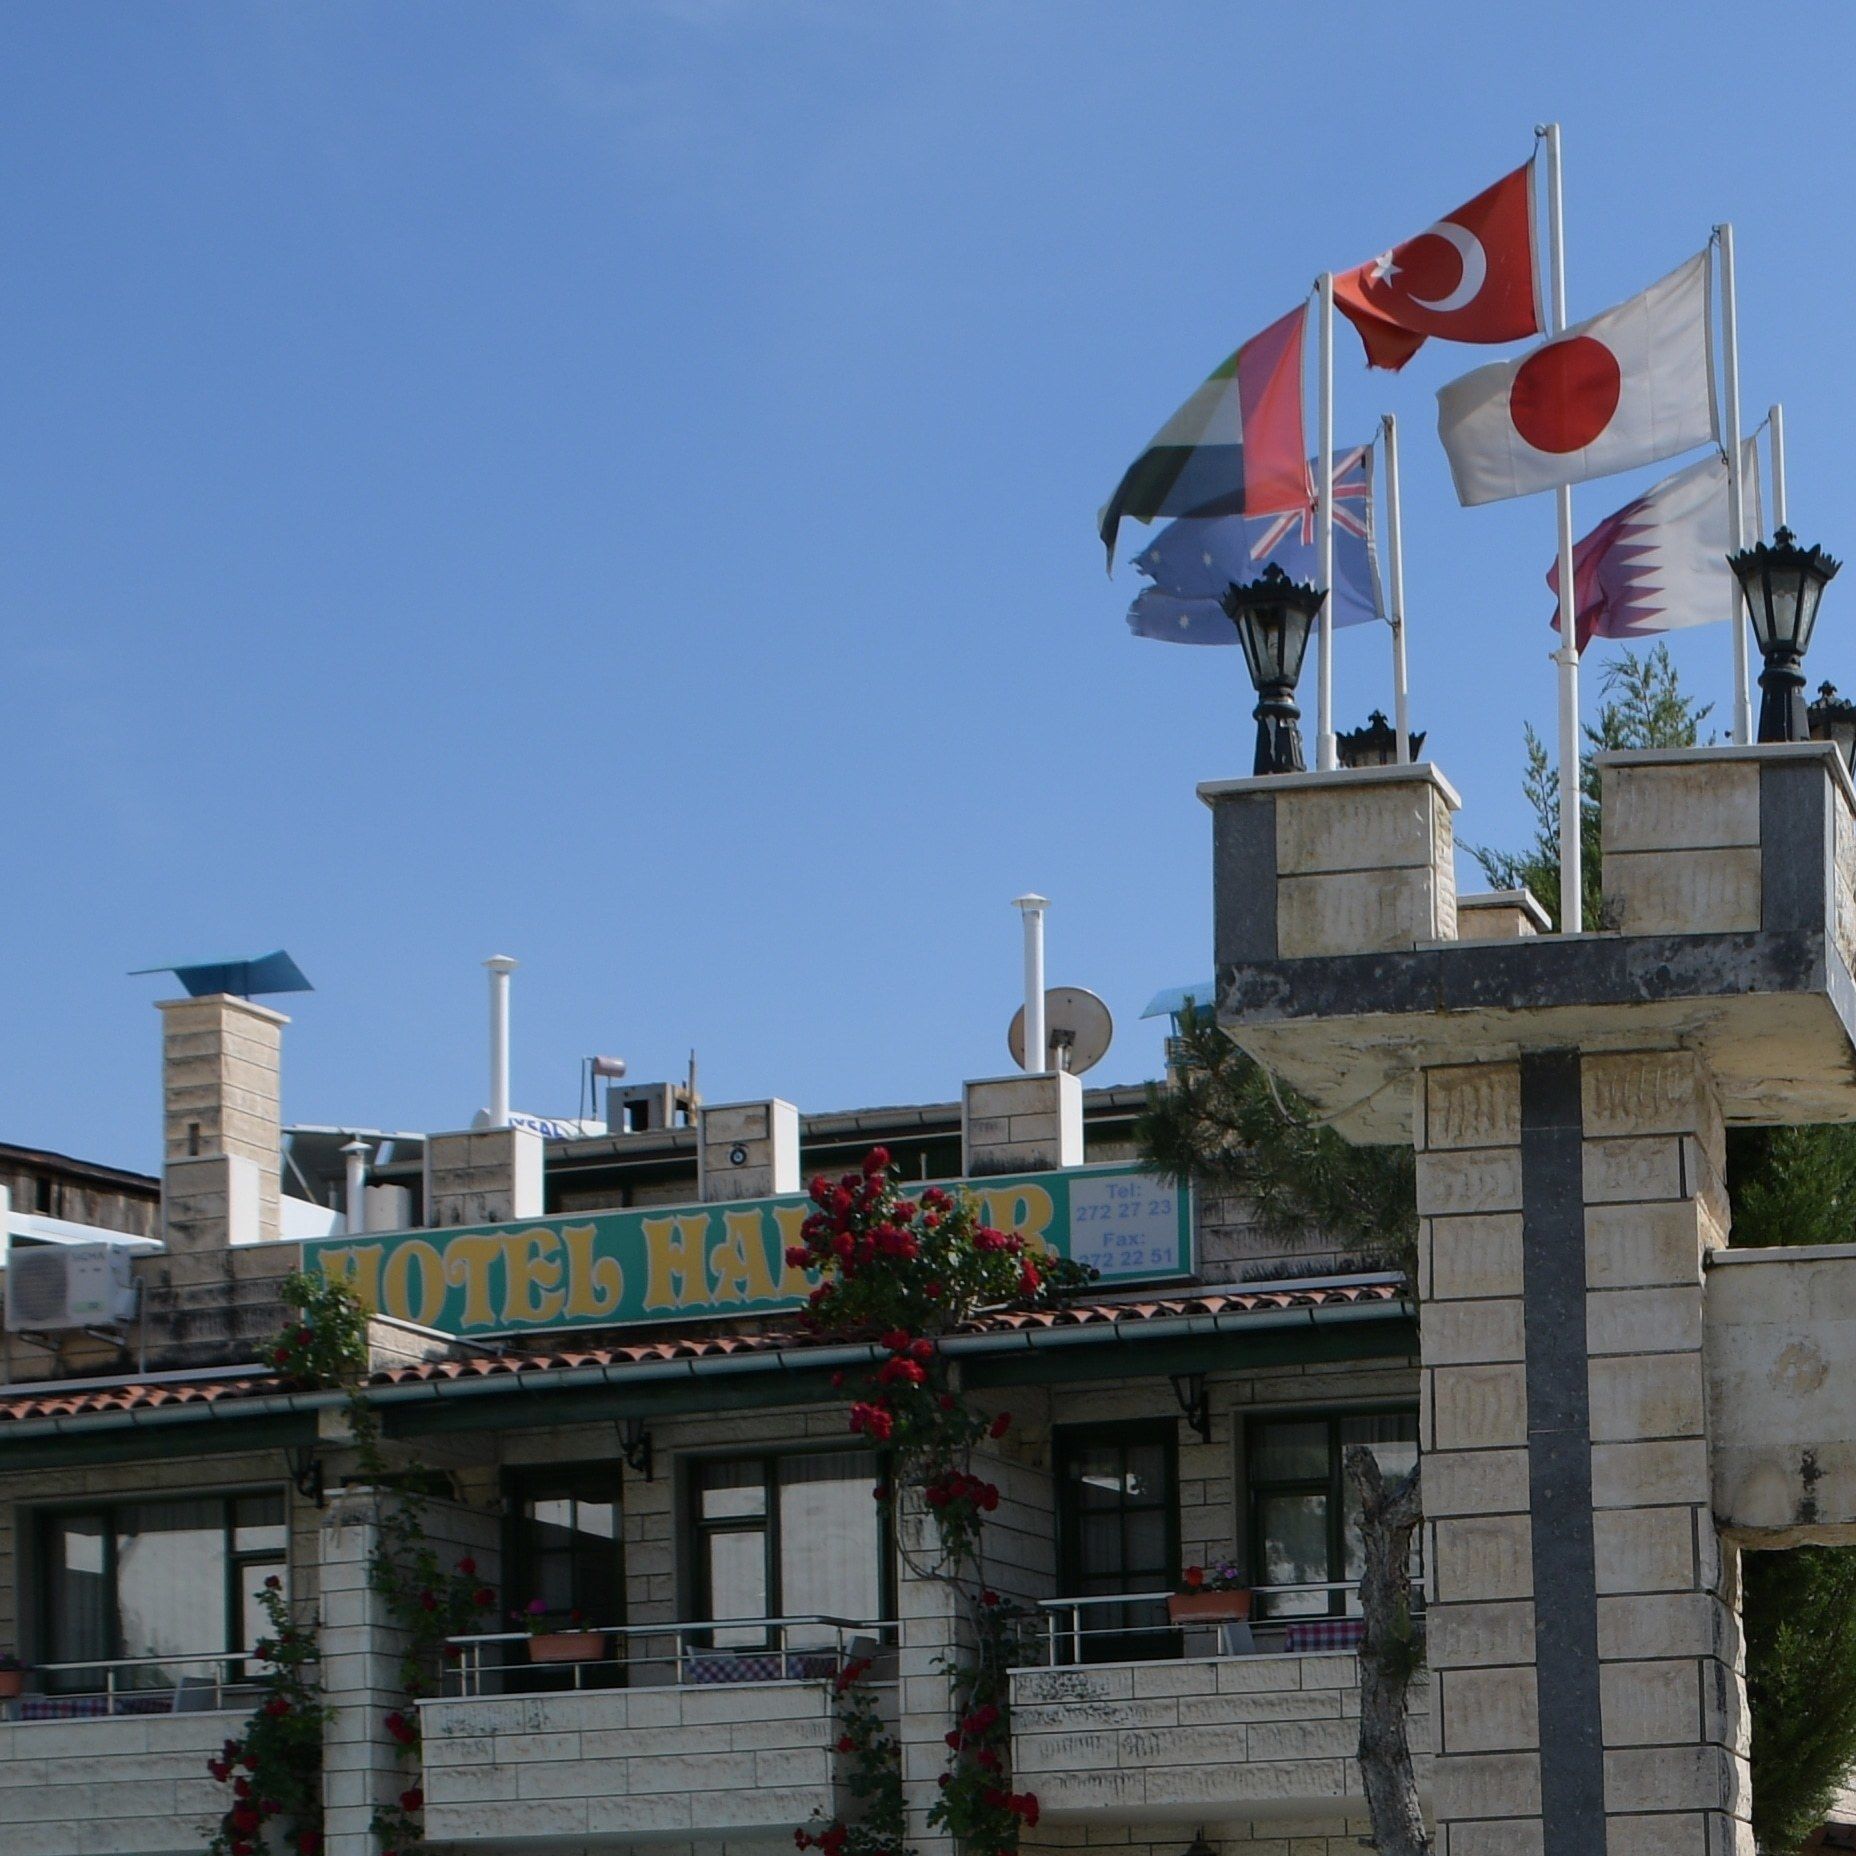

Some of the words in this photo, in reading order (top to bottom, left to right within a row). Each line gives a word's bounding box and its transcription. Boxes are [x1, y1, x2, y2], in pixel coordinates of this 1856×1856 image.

[1105, 1182, 1141, 1199] Tel:
[1076, 1205, 1112, 1222] 272
[1118, 1202, 1141, 1218] 27
[1148, 1199, 1172, 1216] 23
[1103, 1232, 1145, 1248] Fax:
[1120, 1250, 1144, 1266] 22
[317, 1223, 623, 1328] HOTEL
